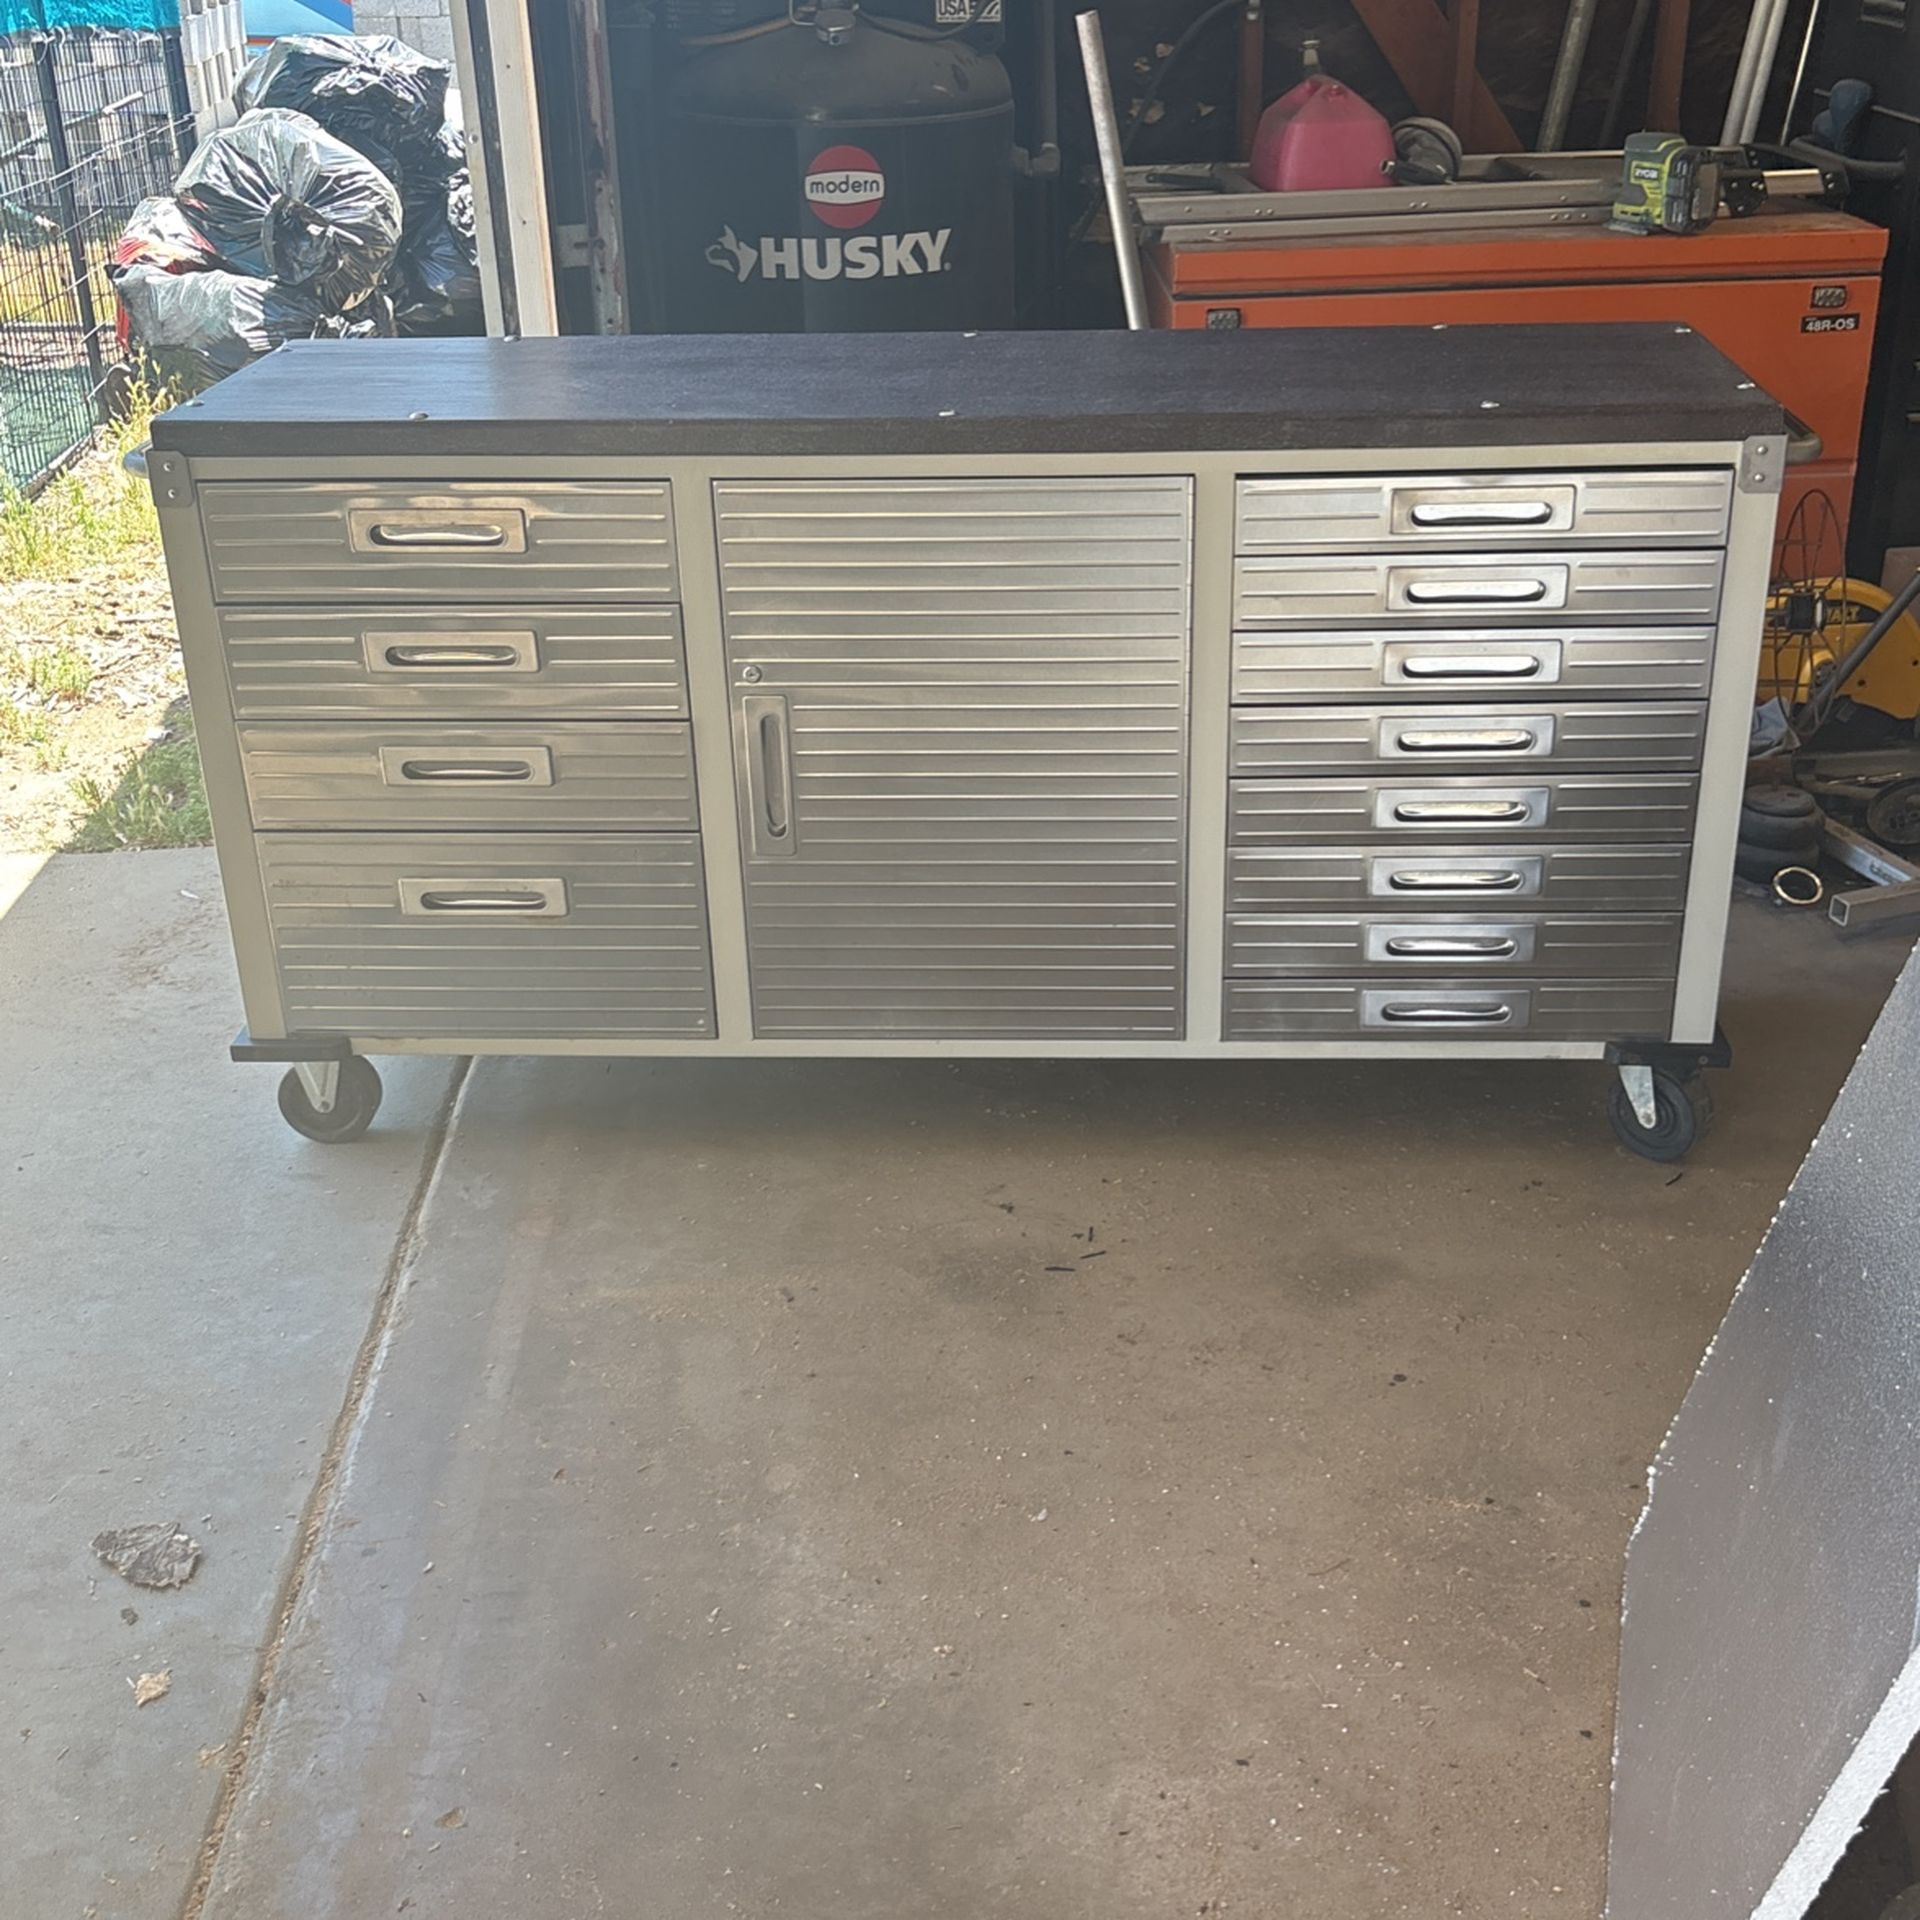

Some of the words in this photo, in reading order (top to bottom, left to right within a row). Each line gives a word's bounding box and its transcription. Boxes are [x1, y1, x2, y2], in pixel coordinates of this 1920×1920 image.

[938, 0, 967, 16] USA
[810, 174, 880, 194] modern
[1805, 317, 1856, 332] 48R-OS
